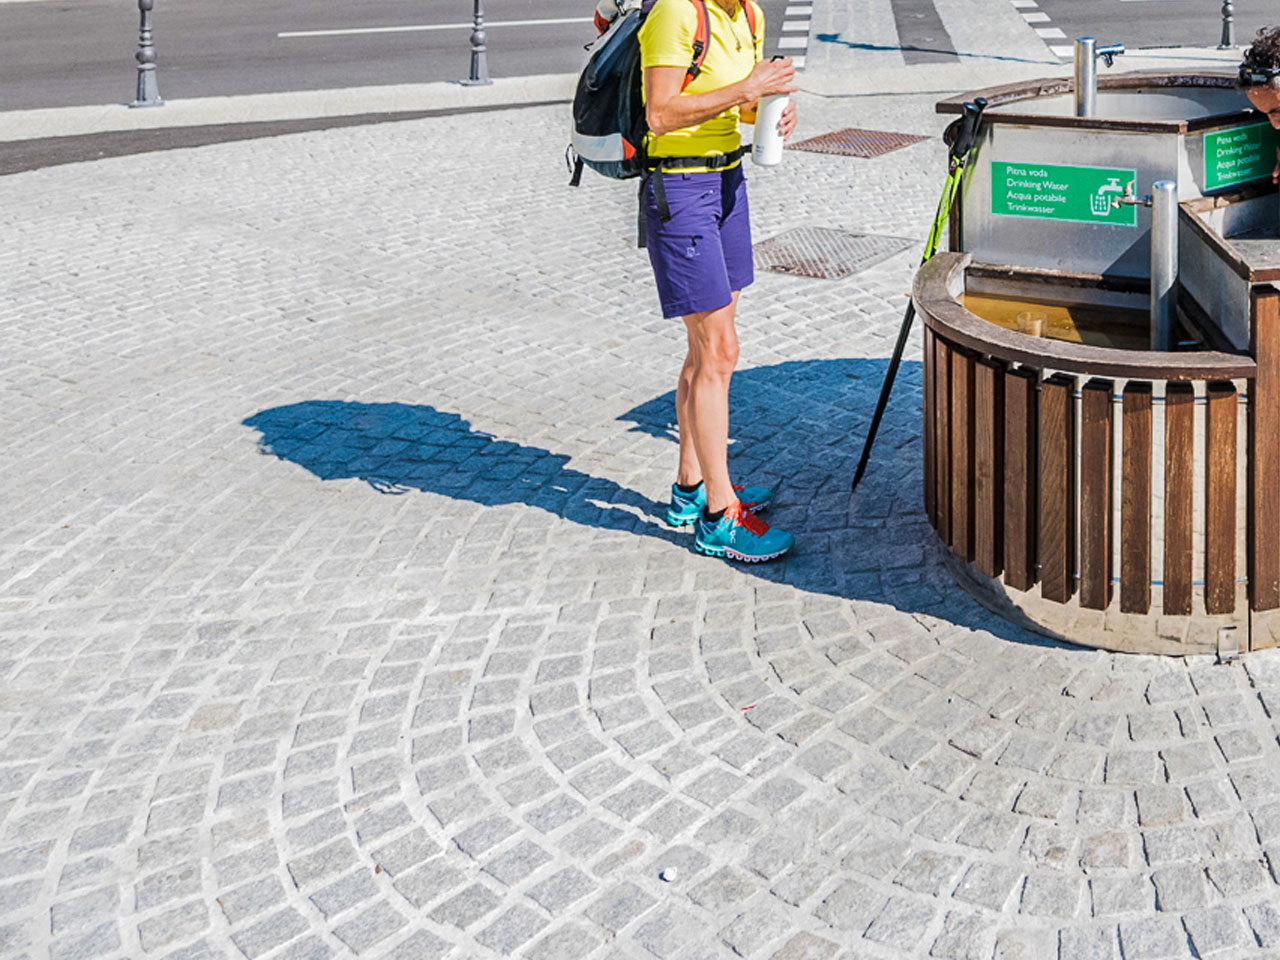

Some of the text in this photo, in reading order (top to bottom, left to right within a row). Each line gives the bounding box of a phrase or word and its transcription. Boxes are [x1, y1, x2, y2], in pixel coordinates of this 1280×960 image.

[1029, 169, 1048, 177] voda
[1006, 178, 1069, 191] Drinking Water
[1006, 190, 1067, 203] Acqua potabile
[1006, 202, 1055, 214] Trinkwasser
